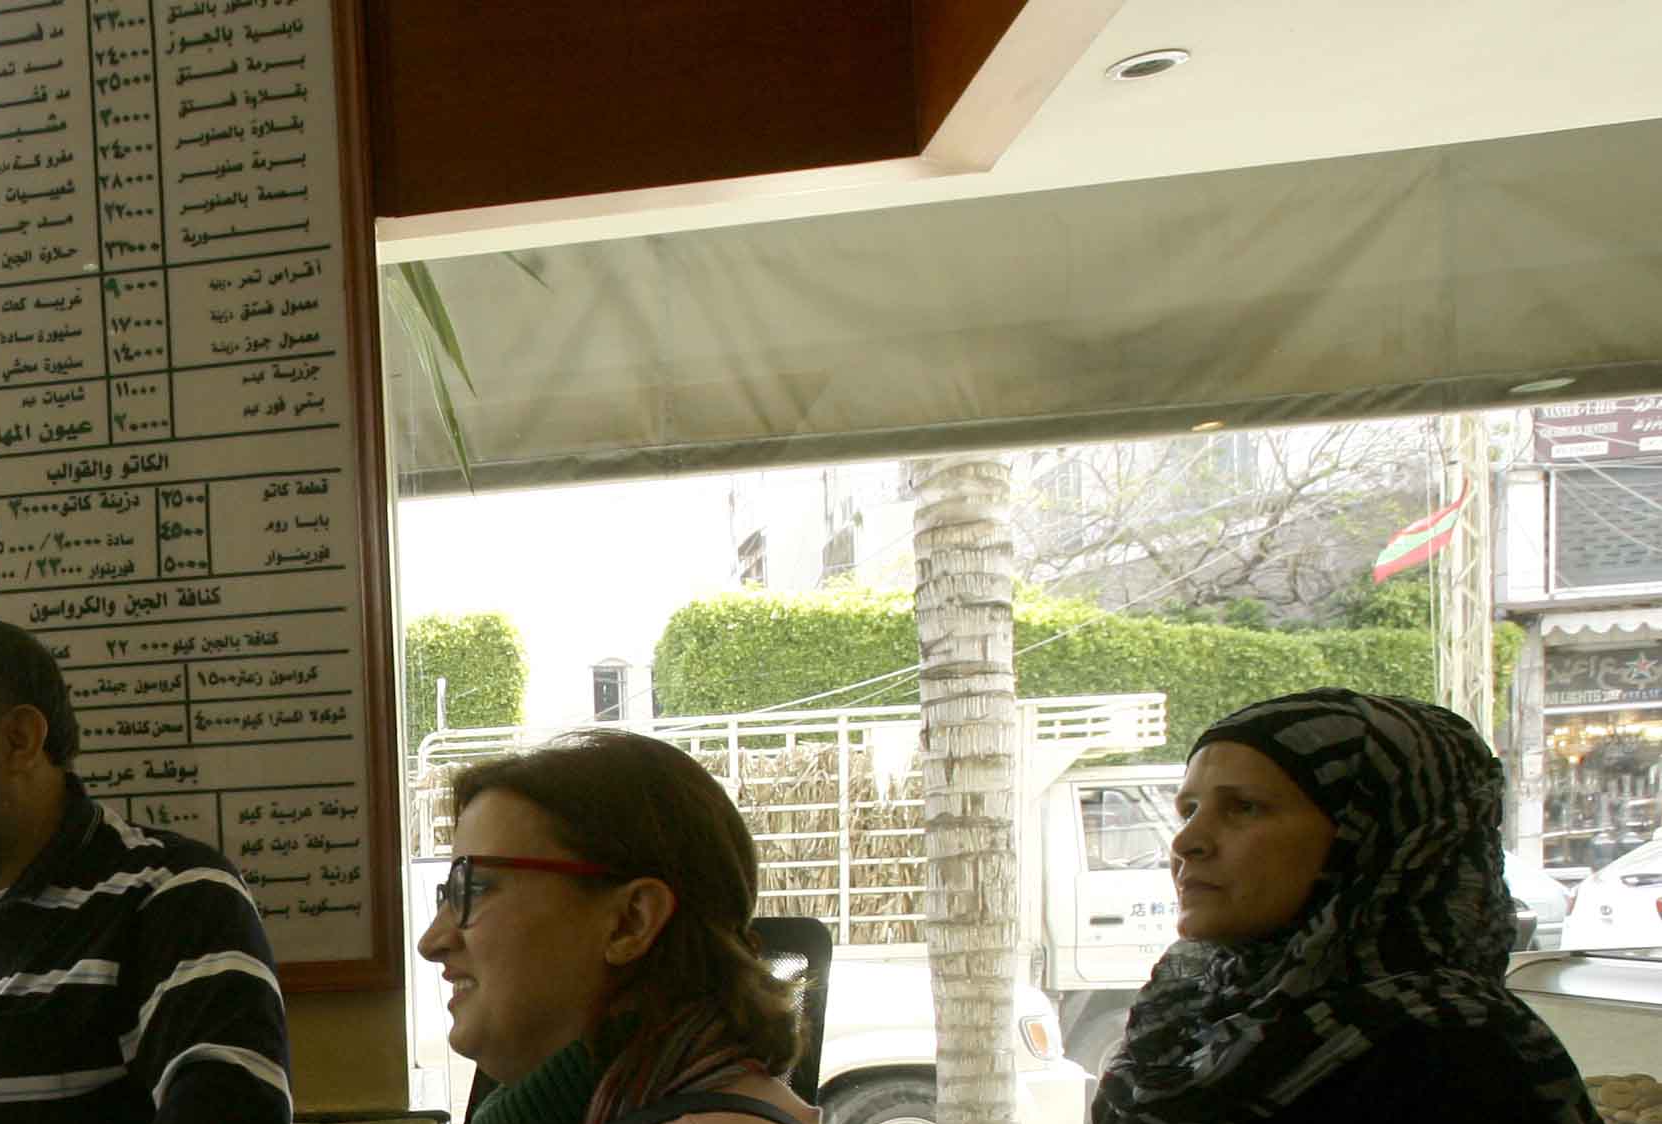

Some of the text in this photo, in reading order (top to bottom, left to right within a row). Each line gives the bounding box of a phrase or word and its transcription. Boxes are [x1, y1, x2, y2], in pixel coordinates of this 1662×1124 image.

[164, 18, 304, 55] نابلسية بالجوز
[176, 54, 307, 87] برمة فستق
[178, 82, 308, 120] بقلاوة فستق
[174, 113, 305, 150] بقلاوة بالصنوبر
[177, 150, 307, 184] برمة صنوبر
[178, 192, 249, 216] بالصنوبر
[237, 268, 262, 289] تمر
[240, 299, 274, 322] فستق
[281, 298, 319, 317] معمول
[245, 336, 271, 353] جوز
[279, 331, 321, 349] معمول
[39, 420, 93, 444] عيون
[46, 452, 170, 486] الكاتو والقوالب
[98, 490, 142, 514] دزينة
[263, 477, 330, 503] قطعة كاتو
[29, 586, 222, 623] كنافة الجبن والكرواسون
